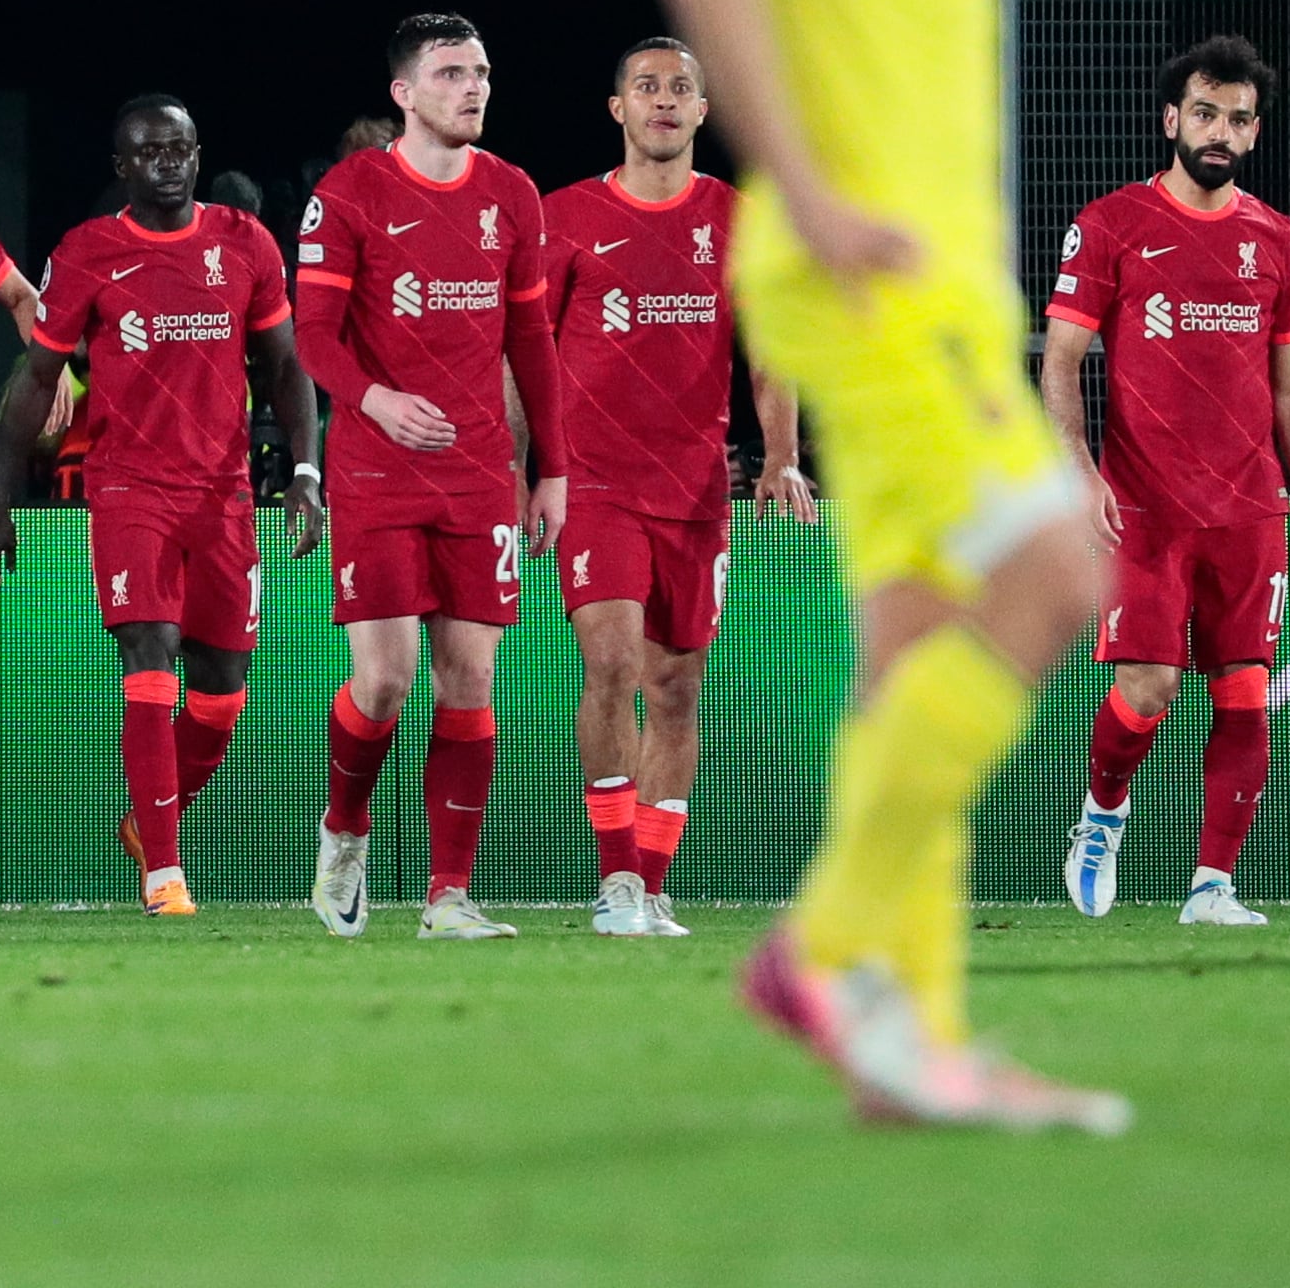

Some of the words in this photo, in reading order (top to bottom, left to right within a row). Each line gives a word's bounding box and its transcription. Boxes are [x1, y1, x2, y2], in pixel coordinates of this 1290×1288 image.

[427, 278, 500, 295] standard
[427, 293, 499, 311] chartered
[637, 293, 717, 309] standard
[1179, 300, 1261, 318] standard
[152, 312, 229, 329] standard
[637, 307, 716, 324] chartered
[1179, 316, 1260, 333] chartered
[153, 325, 231, 342] chartered
